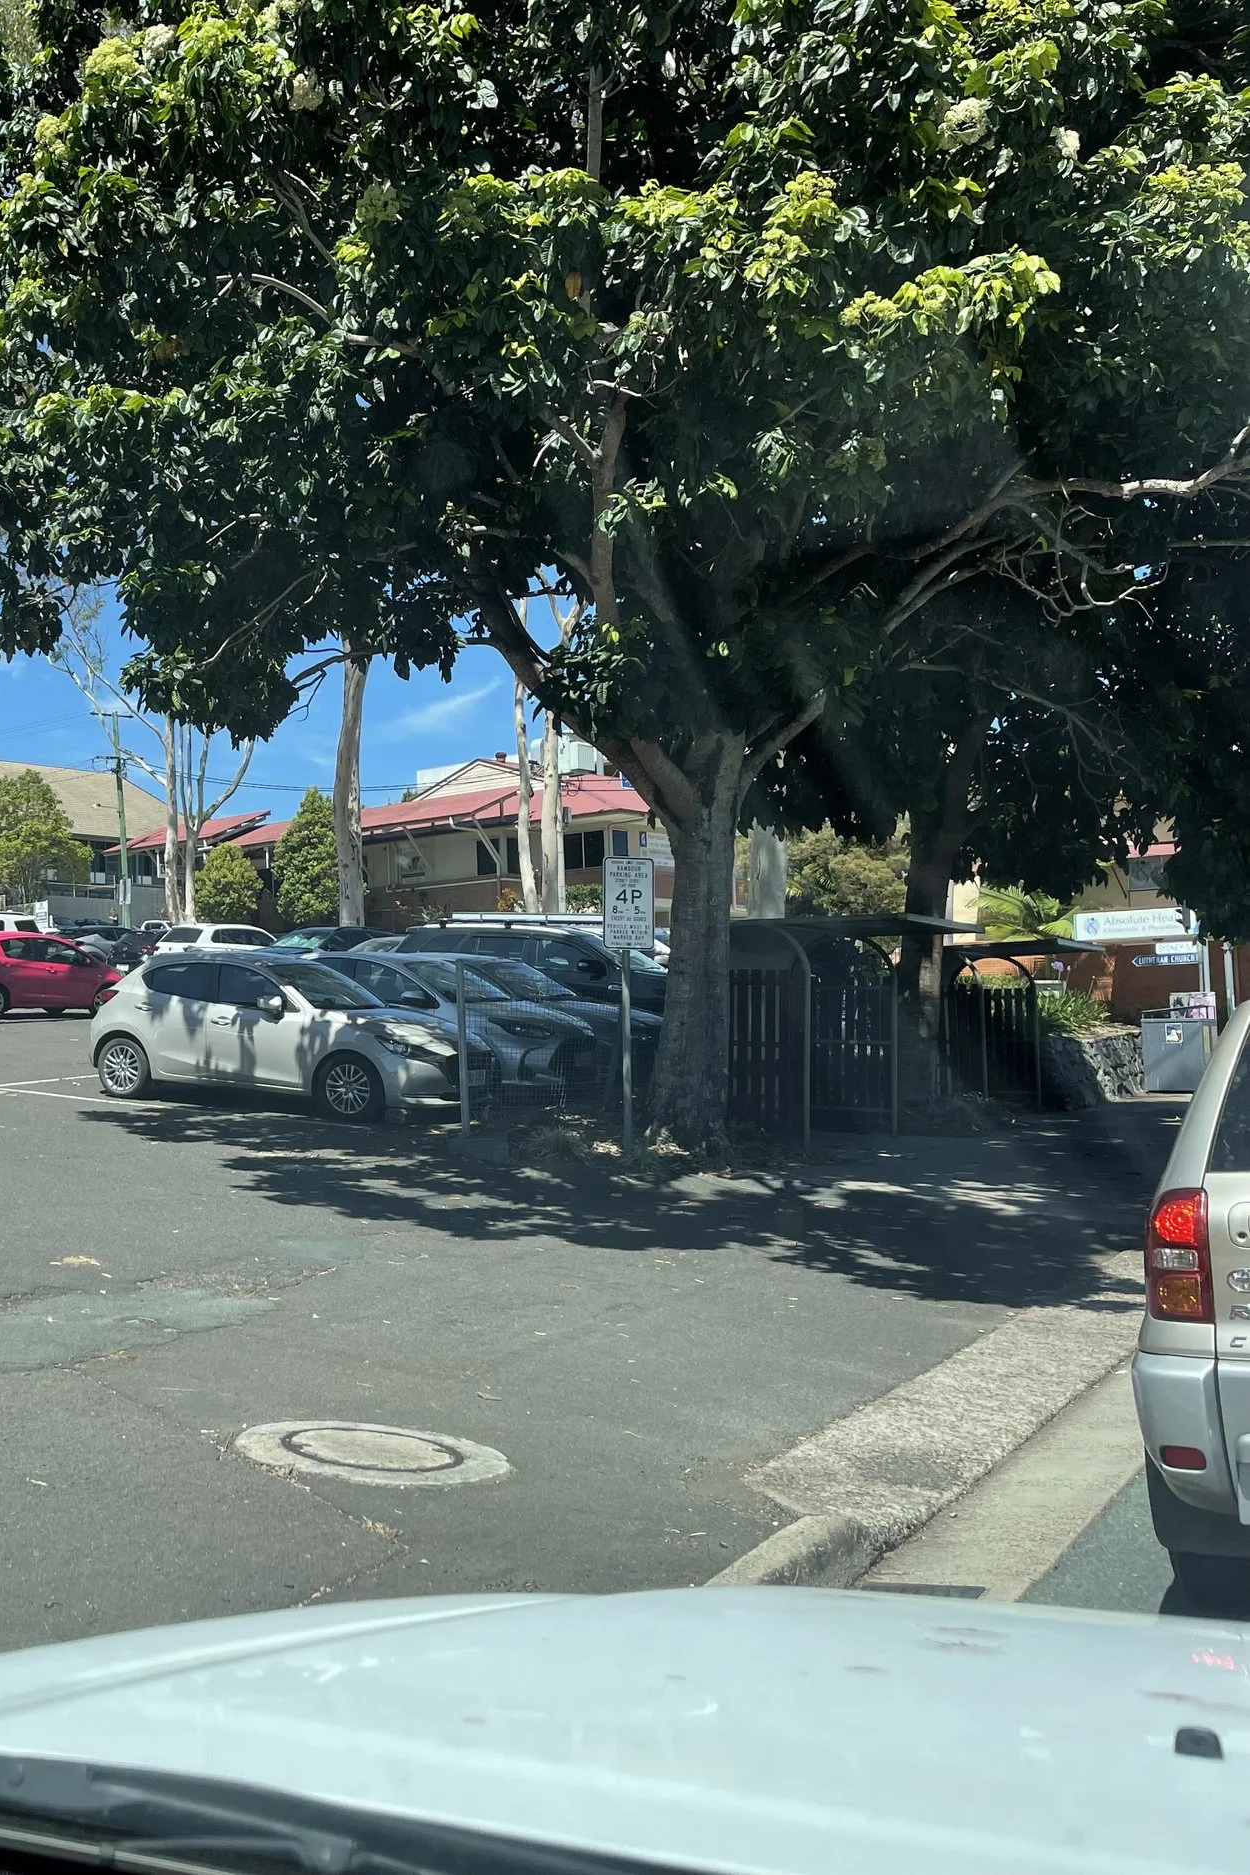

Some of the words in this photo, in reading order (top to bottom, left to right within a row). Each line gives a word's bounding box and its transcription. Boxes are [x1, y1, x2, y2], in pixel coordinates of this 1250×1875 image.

[616, 889, 642, 904] 4P
[1103, 915, 1150, 926] Absolute
[1158, 943, 1183, 953] SYDNEY
[1138, 955, 1168, 965] LUTHERAN
[1170, 953, 1195, 963] CHURCH
